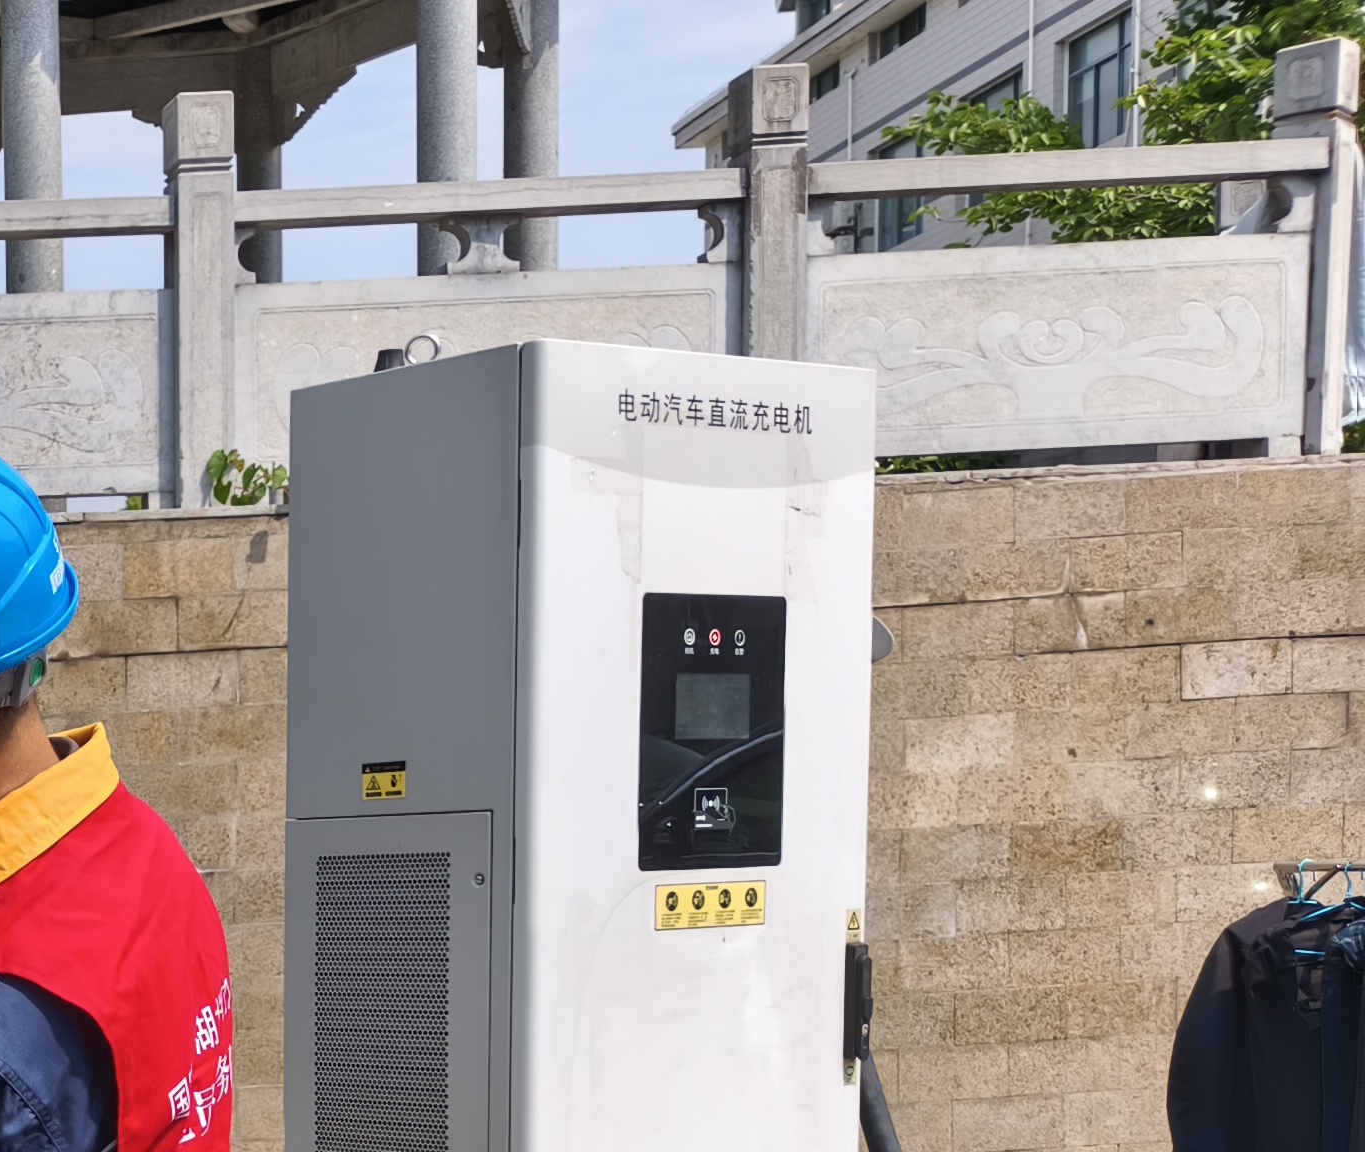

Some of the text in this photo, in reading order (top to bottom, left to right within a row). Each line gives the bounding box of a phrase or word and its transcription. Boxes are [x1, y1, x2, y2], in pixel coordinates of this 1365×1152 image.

[618, 389, 812, 435] 电动汽车直流充电机
